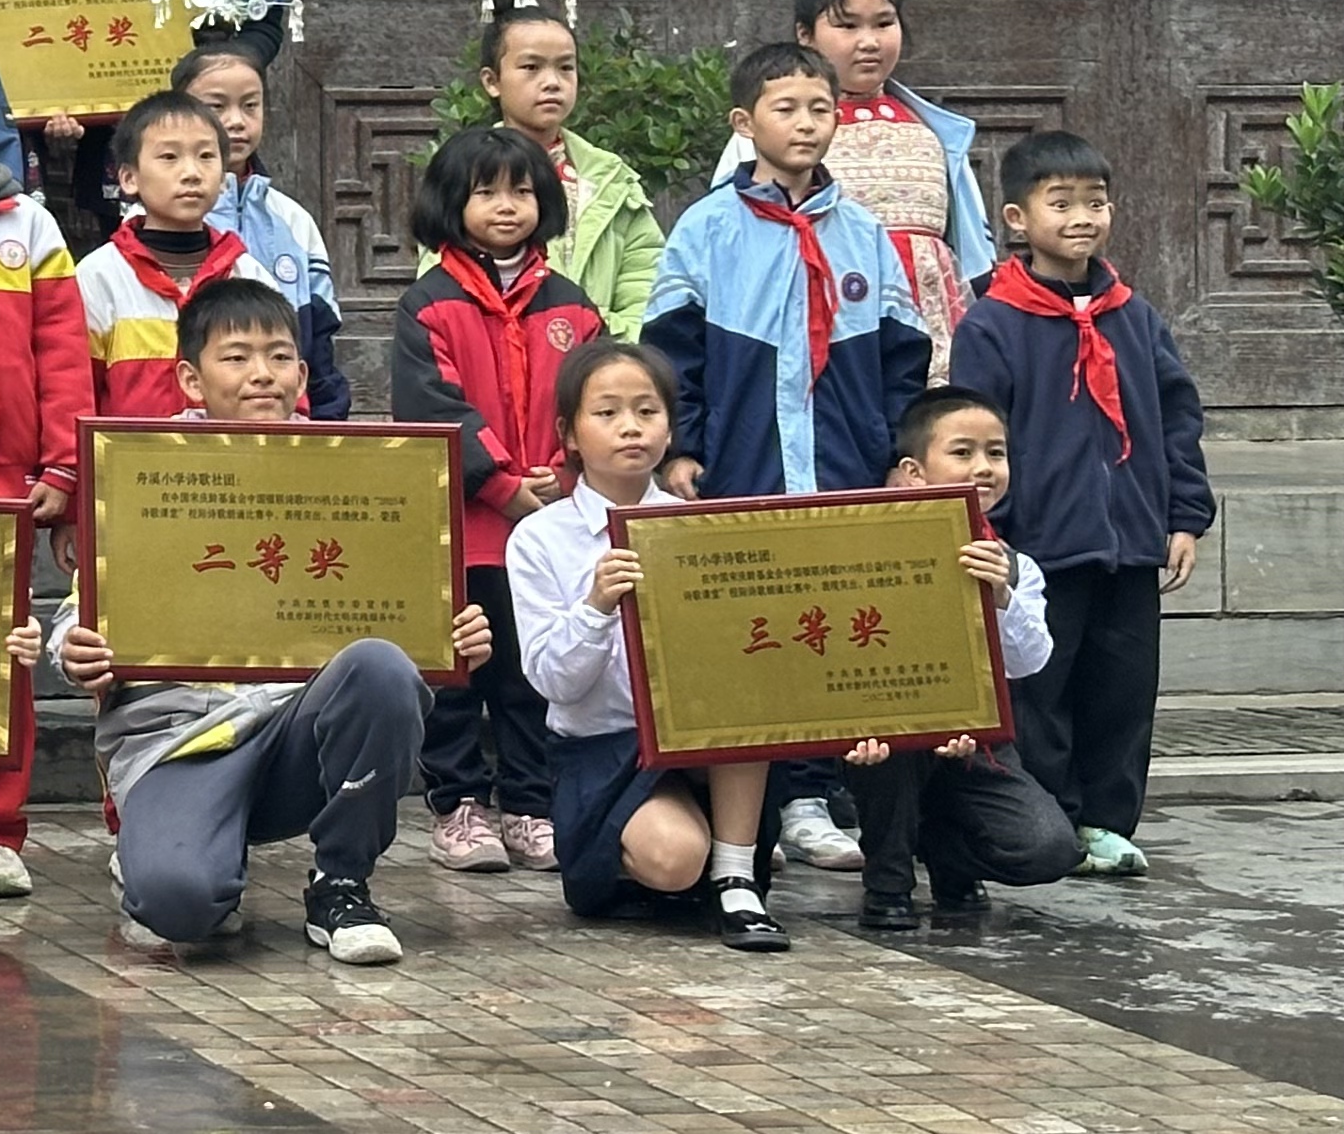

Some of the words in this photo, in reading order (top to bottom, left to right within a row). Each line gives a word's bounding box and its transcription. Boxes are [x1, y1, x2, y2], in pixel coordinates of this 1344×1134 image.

[22, 15, 139, 52] 二等奖
[192, 533, 349, 584] 二等奖
[742, 605, 891, 656] 三等奖
